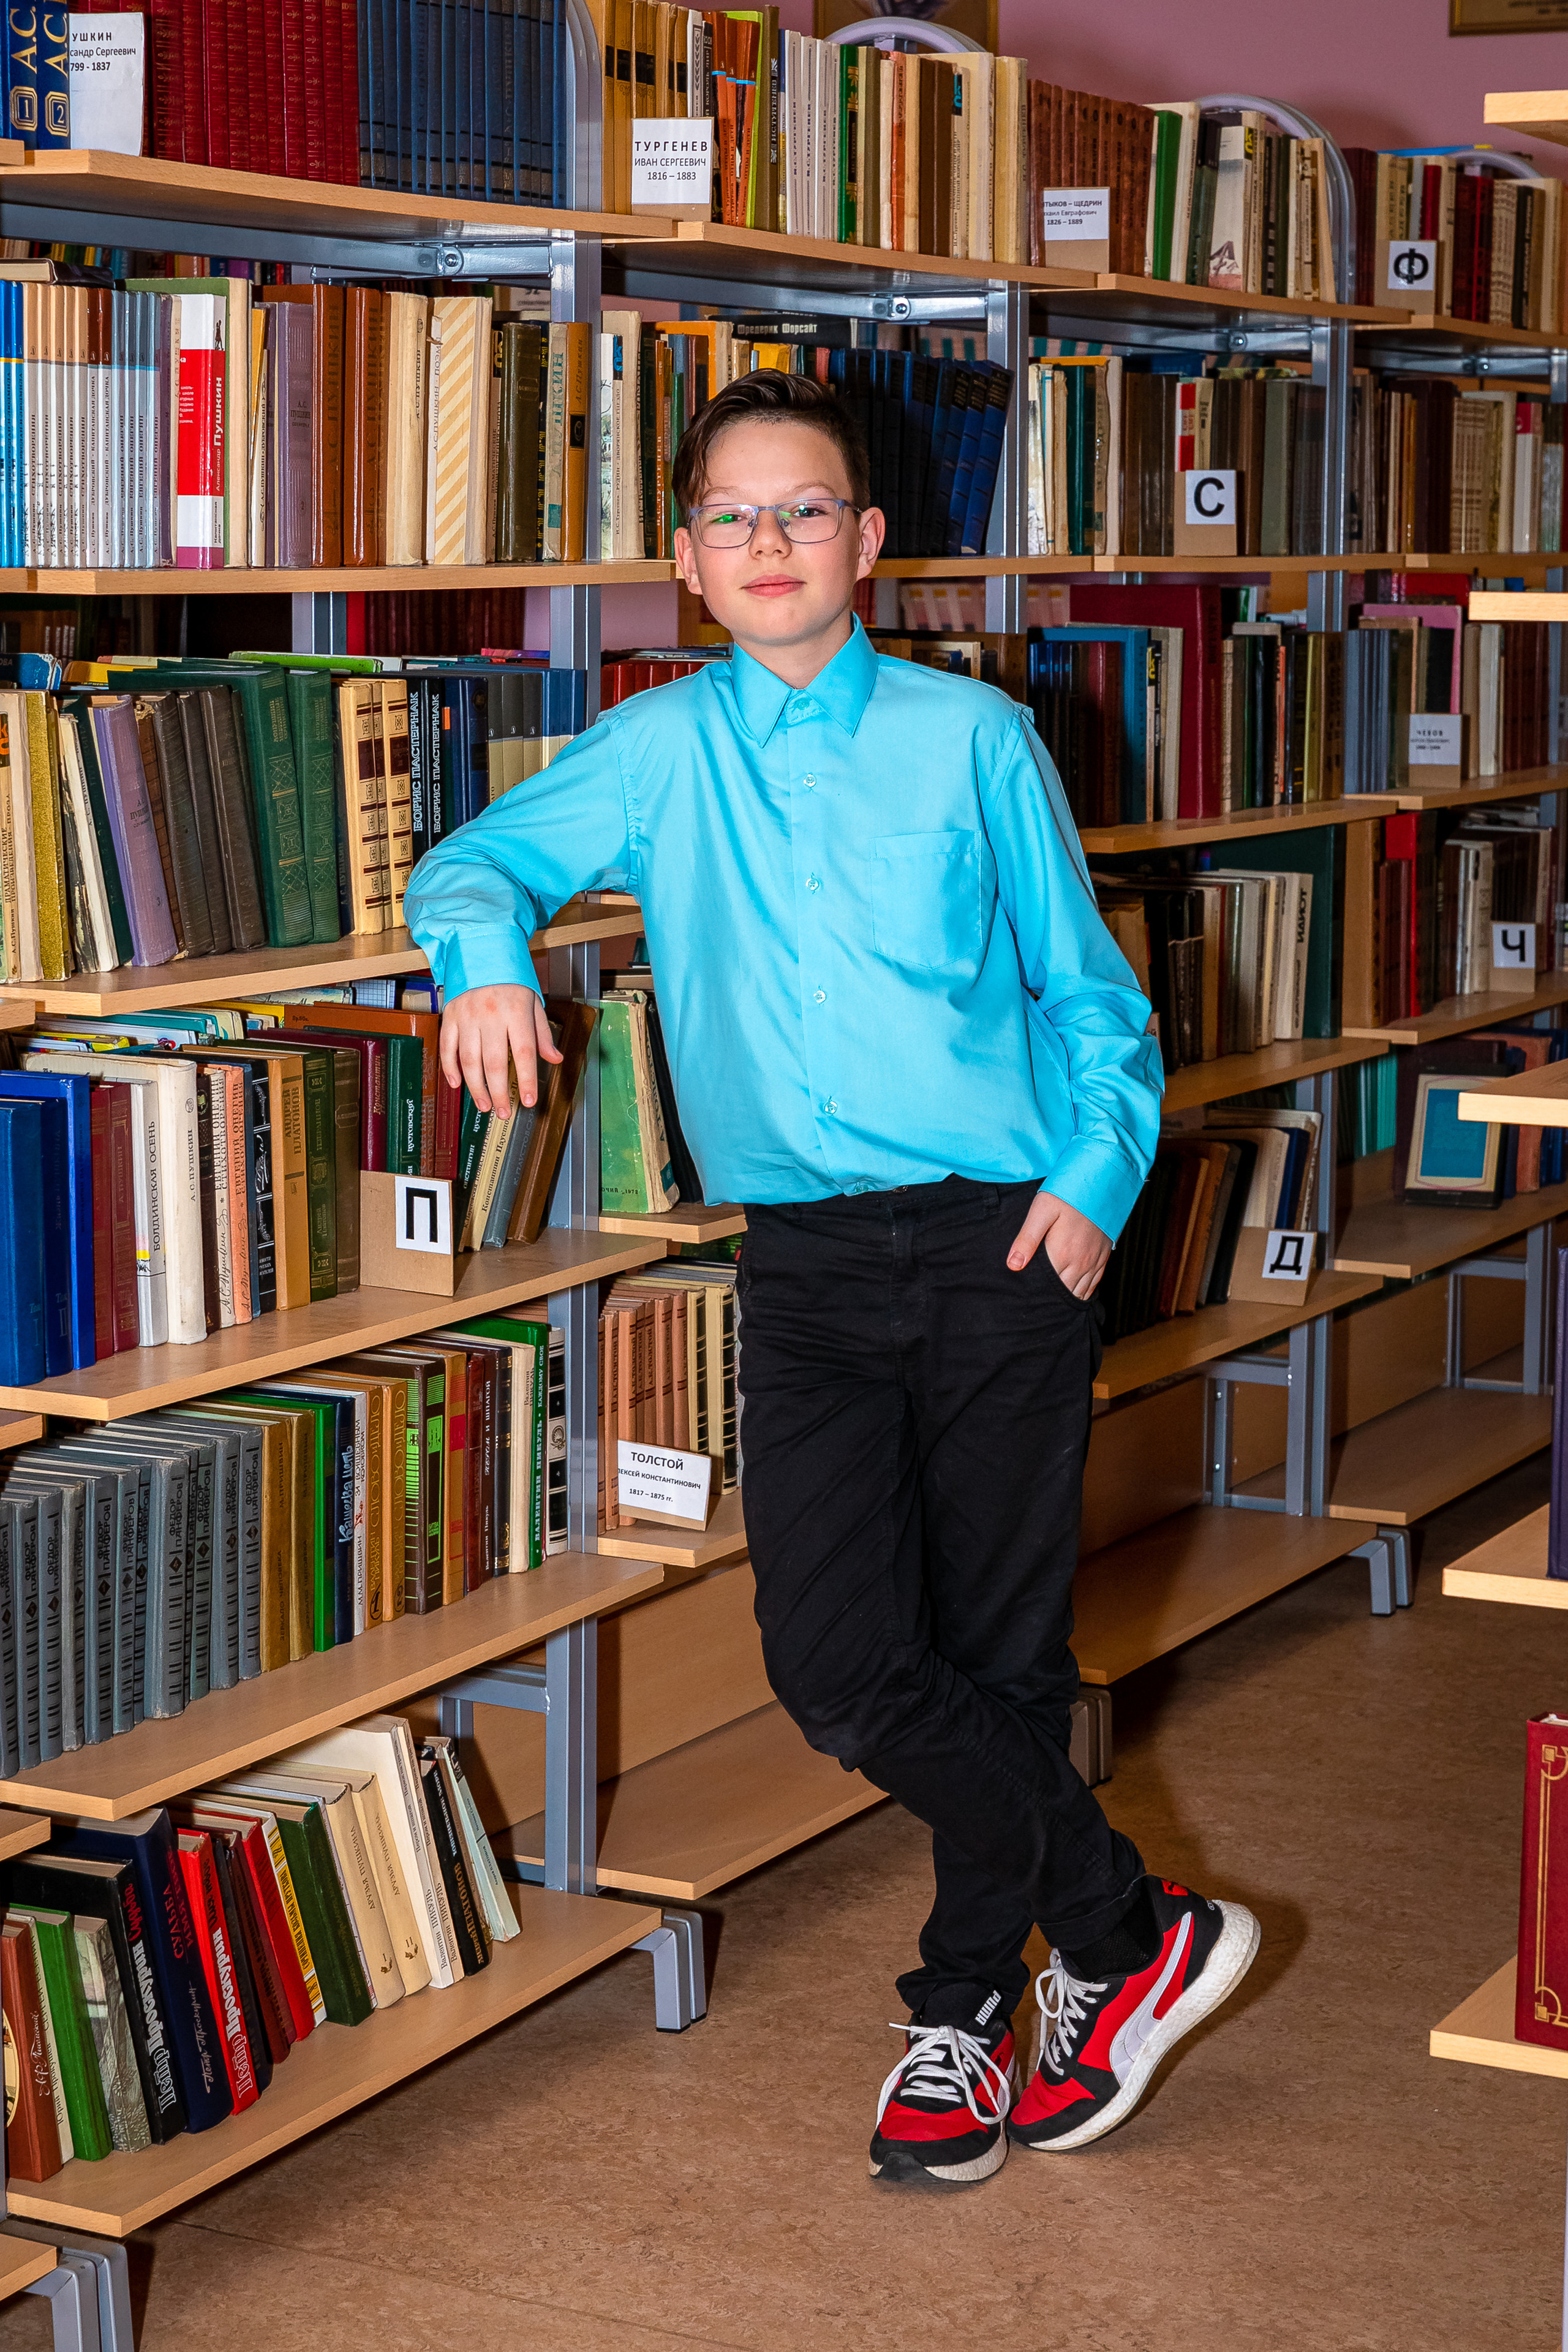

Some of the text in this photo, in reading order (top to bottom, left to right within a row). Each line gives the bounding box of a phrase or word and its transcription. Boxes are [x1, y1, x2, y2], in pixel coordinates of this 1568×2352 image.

[70, 47, 136, 60] сандр Сергеевич
[70, 62, 110, 71] 799 1837
[72, 32, 113, 42] УШКИН
[57, 105, 66, 123] 2
[635, 141, 708, 152] ТУРГЕНЕВ
[635, 157, 707, 167] ИВАН СЕРГЕЕВИЧ
[647, 172, 696, 180] 1816 1883
[1393, 247, 1429, 284] Ф
[213, 377, 223, 447] Пушкин
[1194, 477, 1225, 517] С
[410, 692, 423, 832] БОРИС ПАСТЕРНАК
[432, 694, 441, 834] БОРИС ПАСТЕРНАК
[1, 827, 11, 903] ДРАМАТИЧЕСКИЕ
[7, 832, 16, 902] ПРОИЗВЕДЕНИЯ
[1501, 929, 1526, 962] Ч
[210, 1077, 222, 1190] ЕВГЕНИЙ ОНЕГИН
[219, 1077, 228, 1189] СТИХОТВОРЕНИЯ
[283, 1087, 292, 1137] АНДРЕЙ
[292, 1085, 302, 1154] ПЛАТОНОВ
[148, 1121, 161, 1252] БОЛДИНСКАЯ ОСЕНЬ
[233, 1136, 243, 1195] ЕВГЕНИЙ
[475, 1147, 488, 1182] ПОВЕСТИ
[481, 1156, 500, 1213] Константин
[405, 1186, 438, 1243] П
[1269, 1235, 1305, 1275] Д
[369, 1395, 383, 1526] СЛОВО ДЕЛО
[618, 1468, 701, 1490] ЛЕКСЕЙ КОНСТАНТИНОВИЧ
[631, 1452, 684, 1471] ТОЛСТОЙ
[2, 1531, 10, 1599] ПАНФЕРОВ
[350, 1826, 366, 1876] ПУШКИНА
[374, 1813, 401, 1896] ДРУЗЬЯ ПУШКИНА
[162, 1883, 184, 1959] СУДЬБА
[362, 1877, 375, 1910] ДРУЗЬЯ
[435, 1882, 458, 1963] Валентин ПИКУЛЬ
[453, 1862, 478, 1930] ПЛАТОНОВ
[288, 1903, 309, 1970] СОЧИНЕНИЯ КОЗЬМЫ
[425, 1888, 448, 1969] Валентин ПИКУЛЬ
[123, 1883, 176, 2114] Петр Проскурин Судьба
[213, 1927, 254, 2098] Петр Проскурин
[975, 1990, 1001, 2026] PUMA
[37, 1988, 64, 2126] Юрий Прокушев СЕРГЕЙ
[188, 1981, 214, 2094] Петр Проскурин
